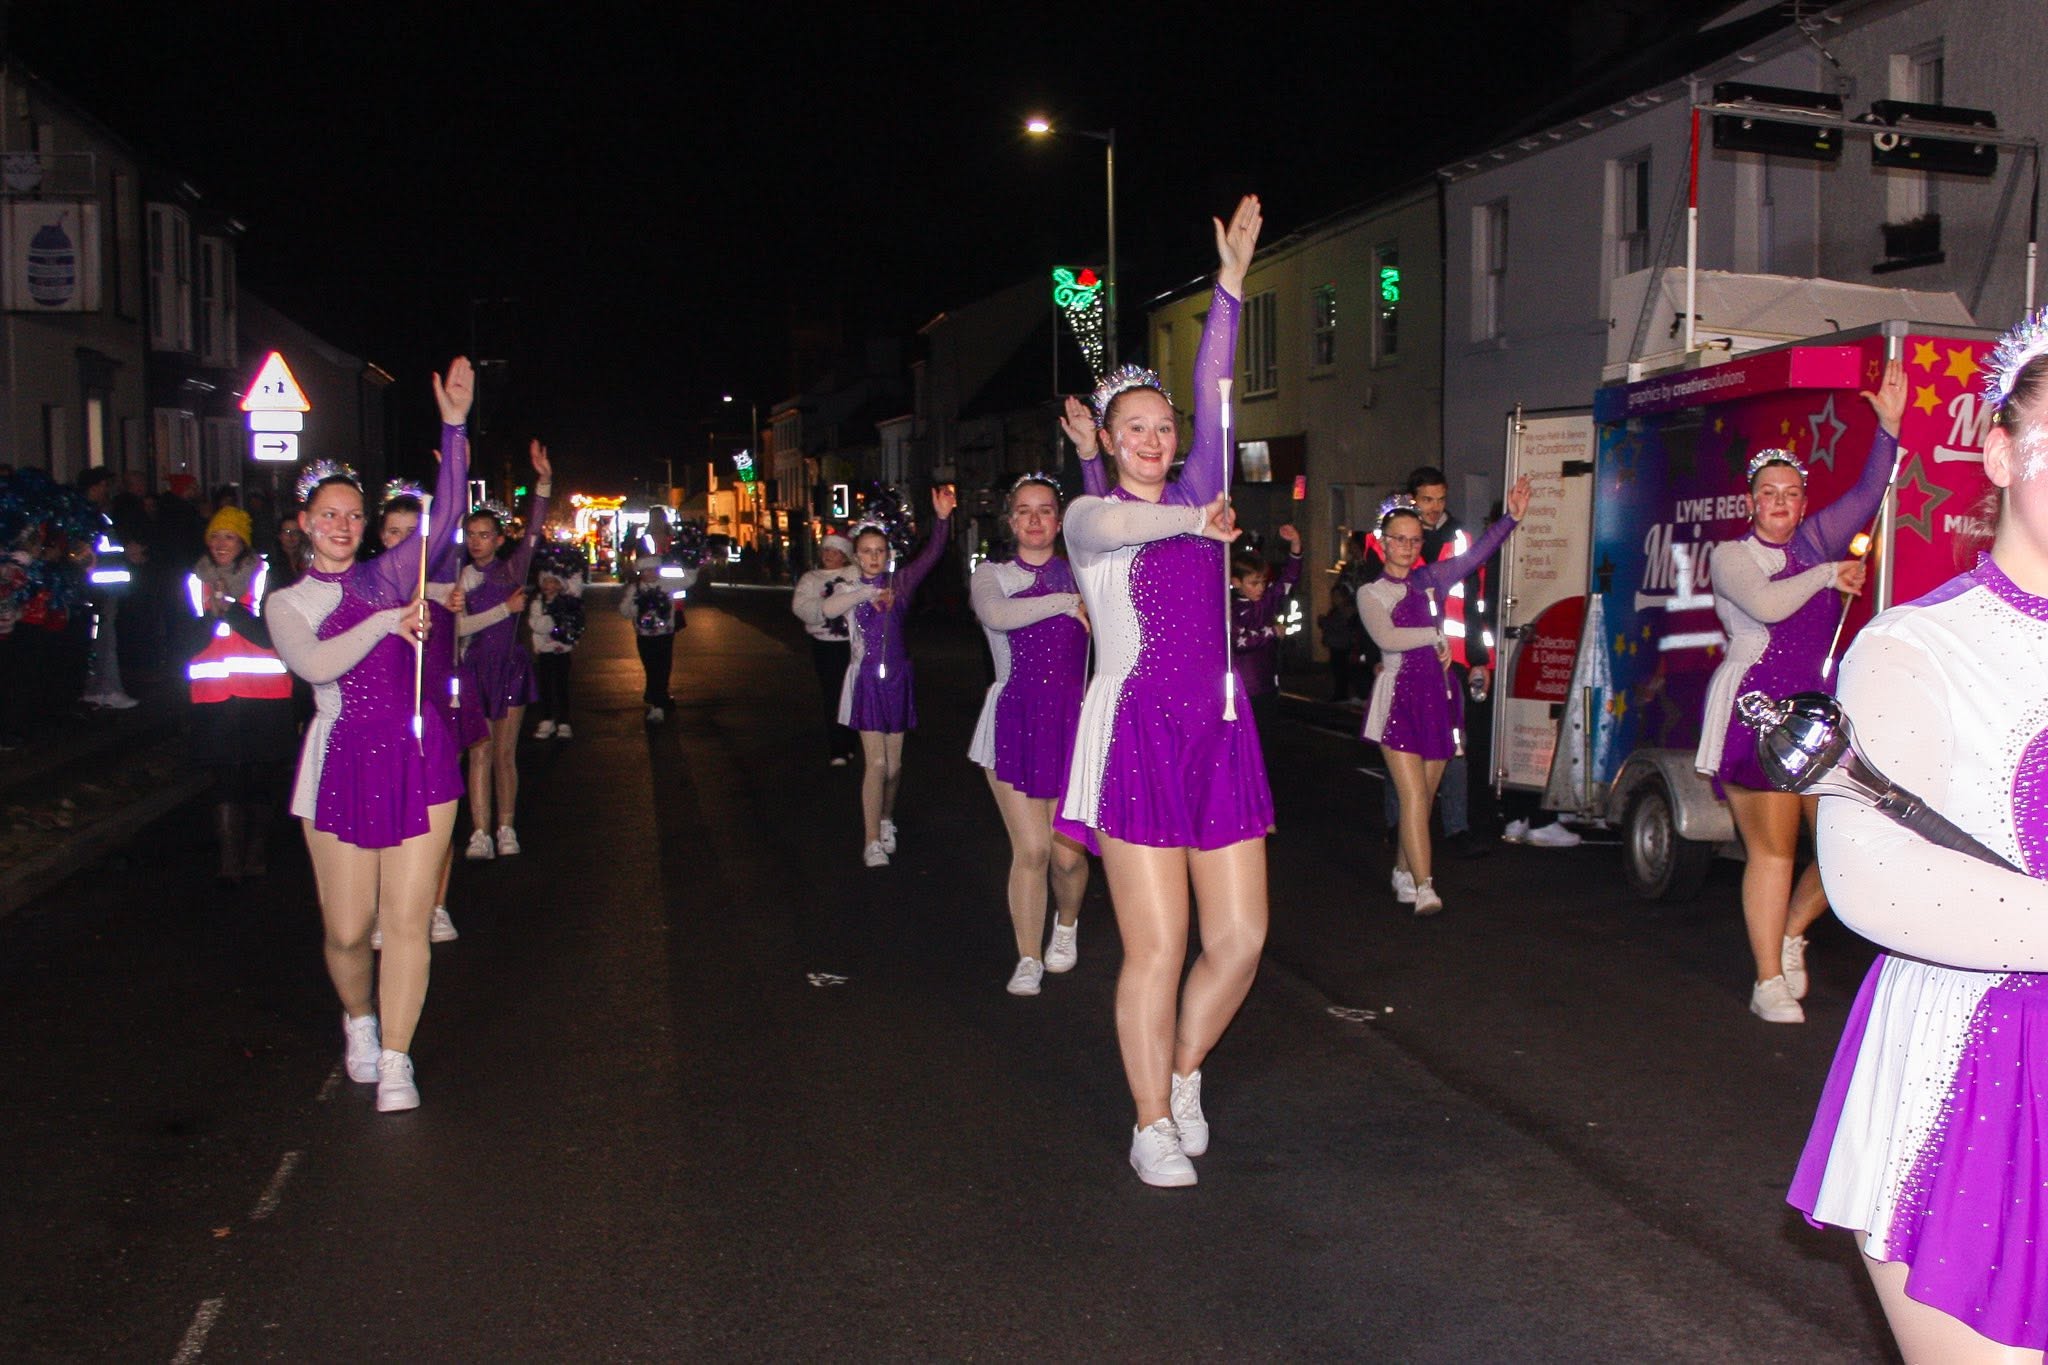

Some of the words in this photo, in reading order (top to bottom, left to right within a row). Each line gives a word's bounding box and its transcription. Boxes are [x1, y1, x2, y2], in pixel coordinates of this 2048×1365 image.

[1536, 442, 1586, 456] Conditioning
[1676, 498, 1713, 522] LYME
[1716, 494, 1746, 520] REG
[1533, 636, 1576, 649] Collection
